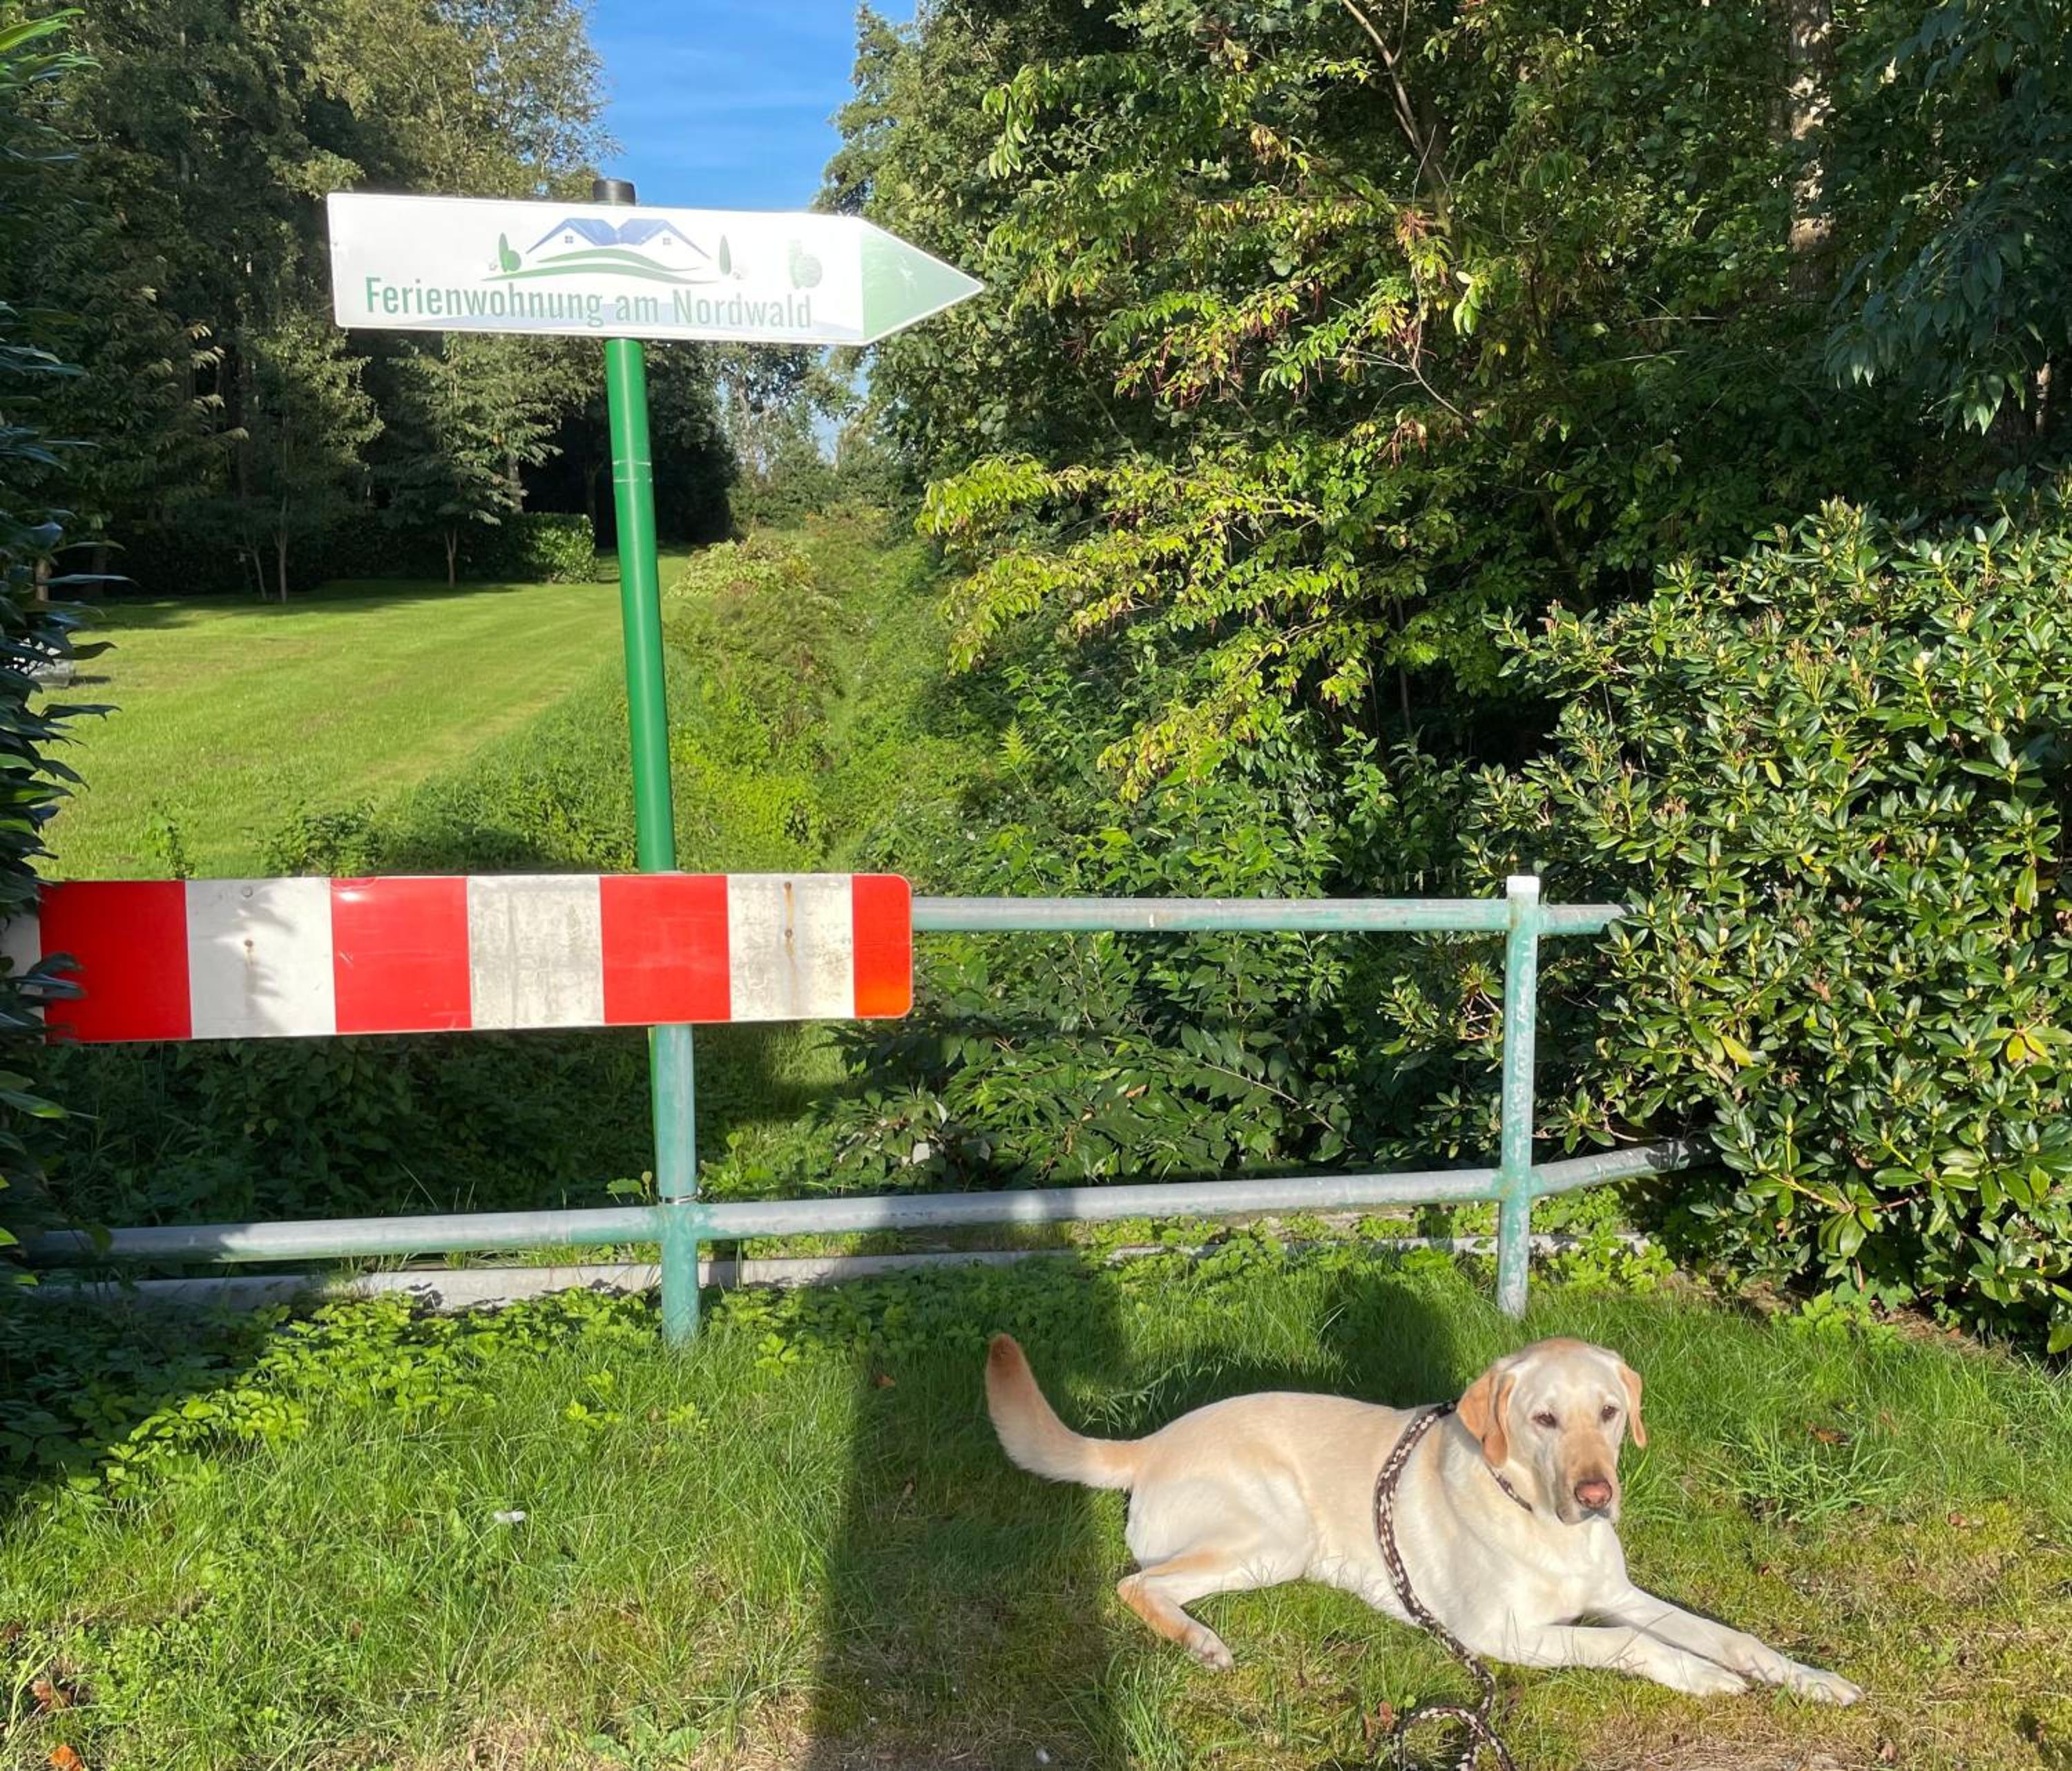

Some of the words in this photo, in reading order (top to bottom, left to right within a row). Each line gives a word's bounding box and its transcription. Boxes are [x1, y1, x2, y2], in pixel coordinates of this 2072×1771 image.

[366, 277, 603, 327] Ferienwohnung
[615, 294, 658, 323] am
[673, 289, 811, 328] Nordwald
